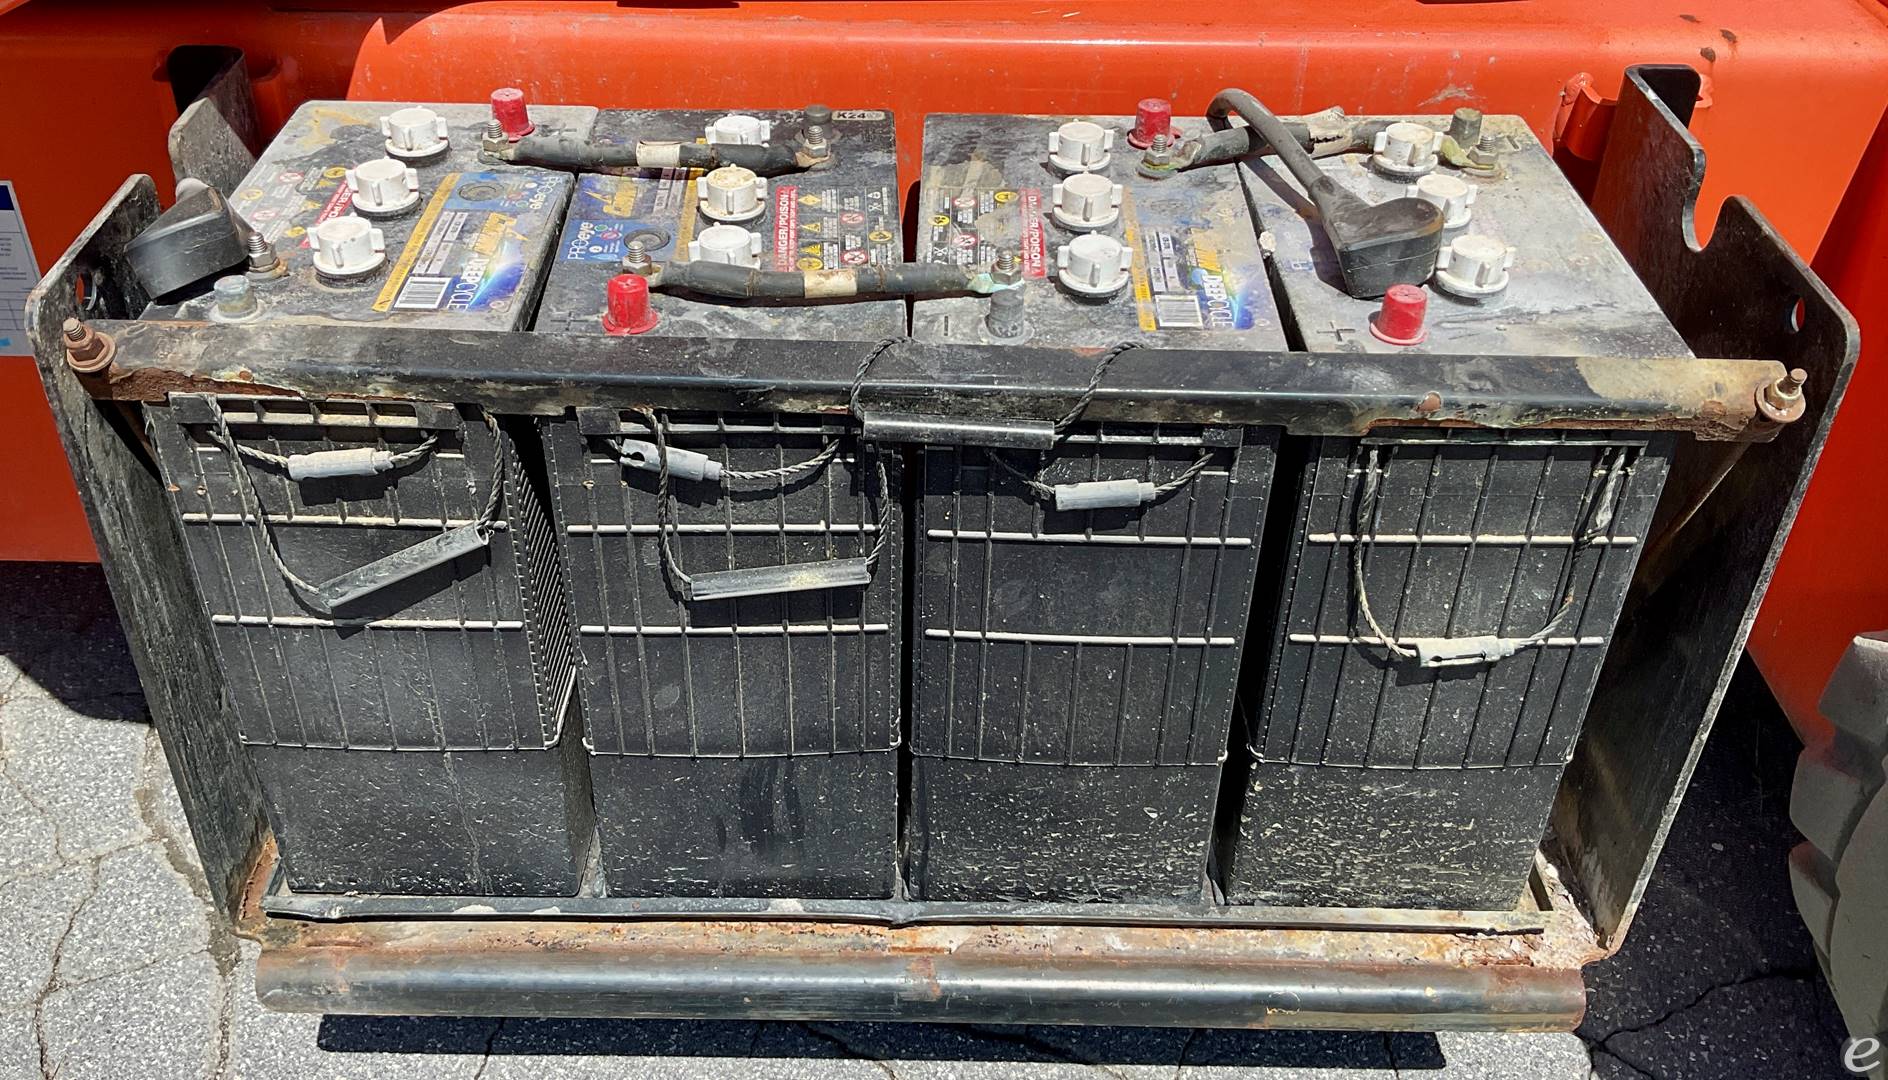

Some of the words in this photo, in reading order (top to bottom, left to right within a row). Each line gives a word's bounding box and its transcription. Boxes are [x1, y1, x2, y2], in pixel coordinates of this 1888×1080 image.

[567, 220, 595, 261] PROeye
[777, 193, 790, 266] DANGER/POISON
[447, 258, 490, 313] DEEPCYCLE
[1202, 275, 1234, 328] DEEPCYCLE
